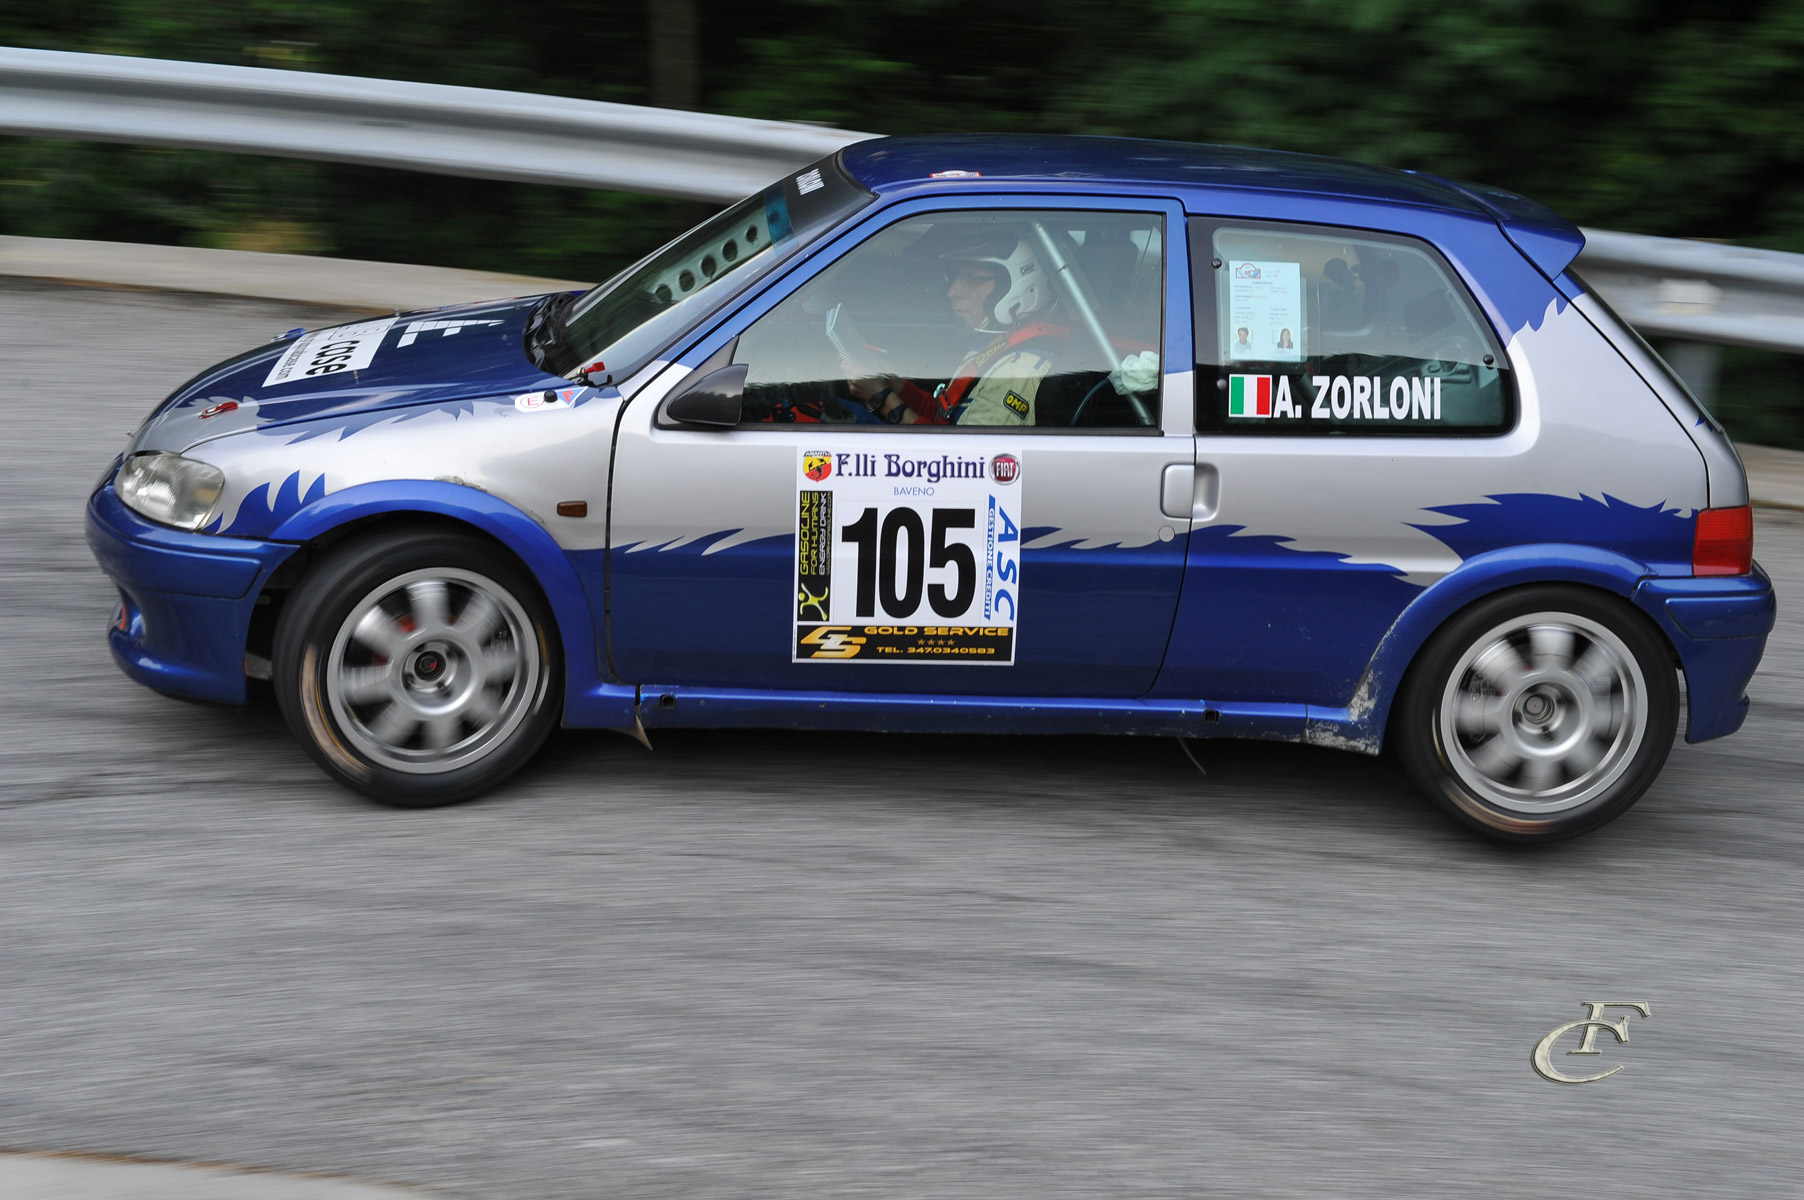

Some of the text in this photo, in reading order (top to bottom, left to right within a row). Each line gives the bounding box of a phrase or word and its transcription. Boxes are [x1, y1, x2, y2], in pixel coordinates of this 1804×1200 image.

[305, 340, 360, 376] case
[1005, 394, 1027, 412] OMP
[1273, 375, 1441, 420] A. ZORLONI
[835, 453, 986, 484] F.lli Borghini
[995, 462, 1015, 477] FIAT
[893, 486, 935, 496] BAVENO
[800, 491, 810, 576] GASOLINE
[811, 492, 819, 547] HUMANS
[841, 506, 977, 619] 105
[984, 507, 995, 616] GESTIONE CREDITI
[994, 505, 1018, 622] ASC
[864, 626, 1009, 637] GOLD SERVICE
[876, 646, 904, 654] TEL.
